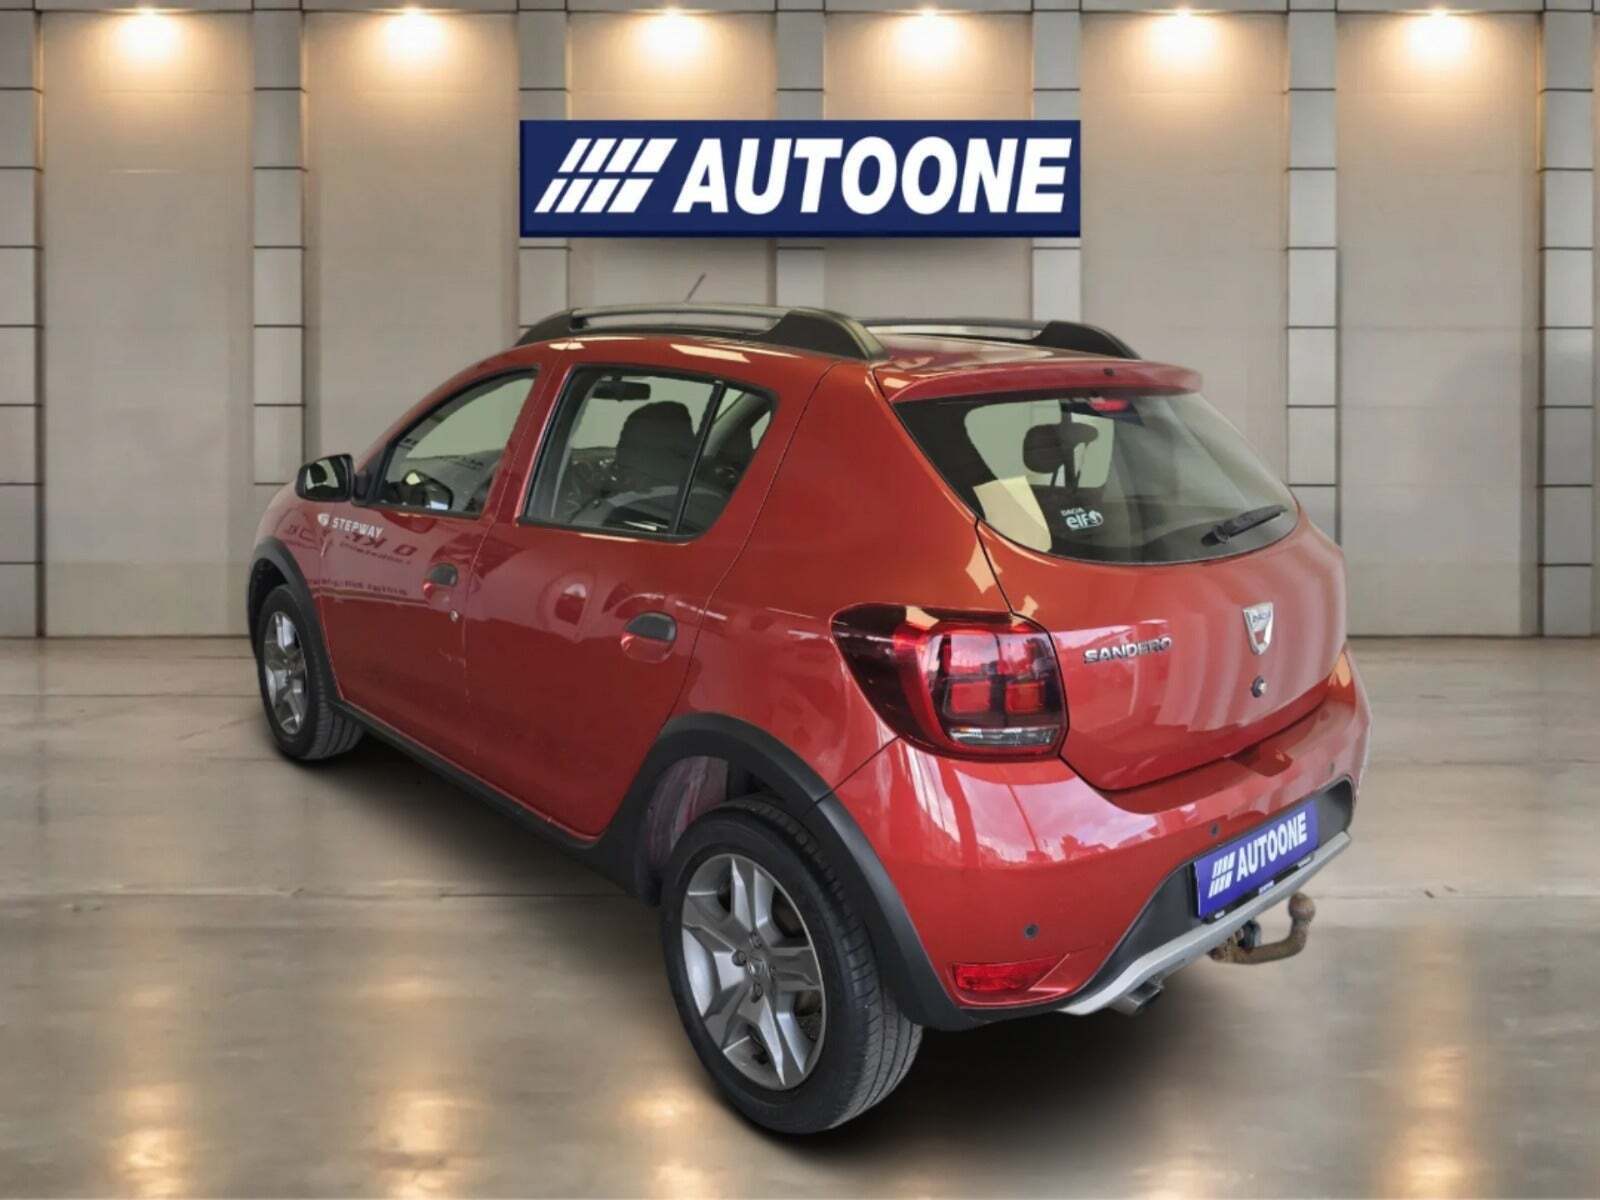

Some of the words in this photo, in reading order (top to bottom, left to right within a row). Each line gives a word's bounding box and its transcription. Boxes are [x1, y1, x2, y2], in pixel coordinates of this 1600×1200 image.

[673, 136, 1072, 215] AUTOONE
[332, 518, 384, 538] STEPWAY
[1066, 512, 1089, 529] elf
[1083, 636, 1172, 664] SANDERO
[1237, 812, 1308, 882] AUTOONE
